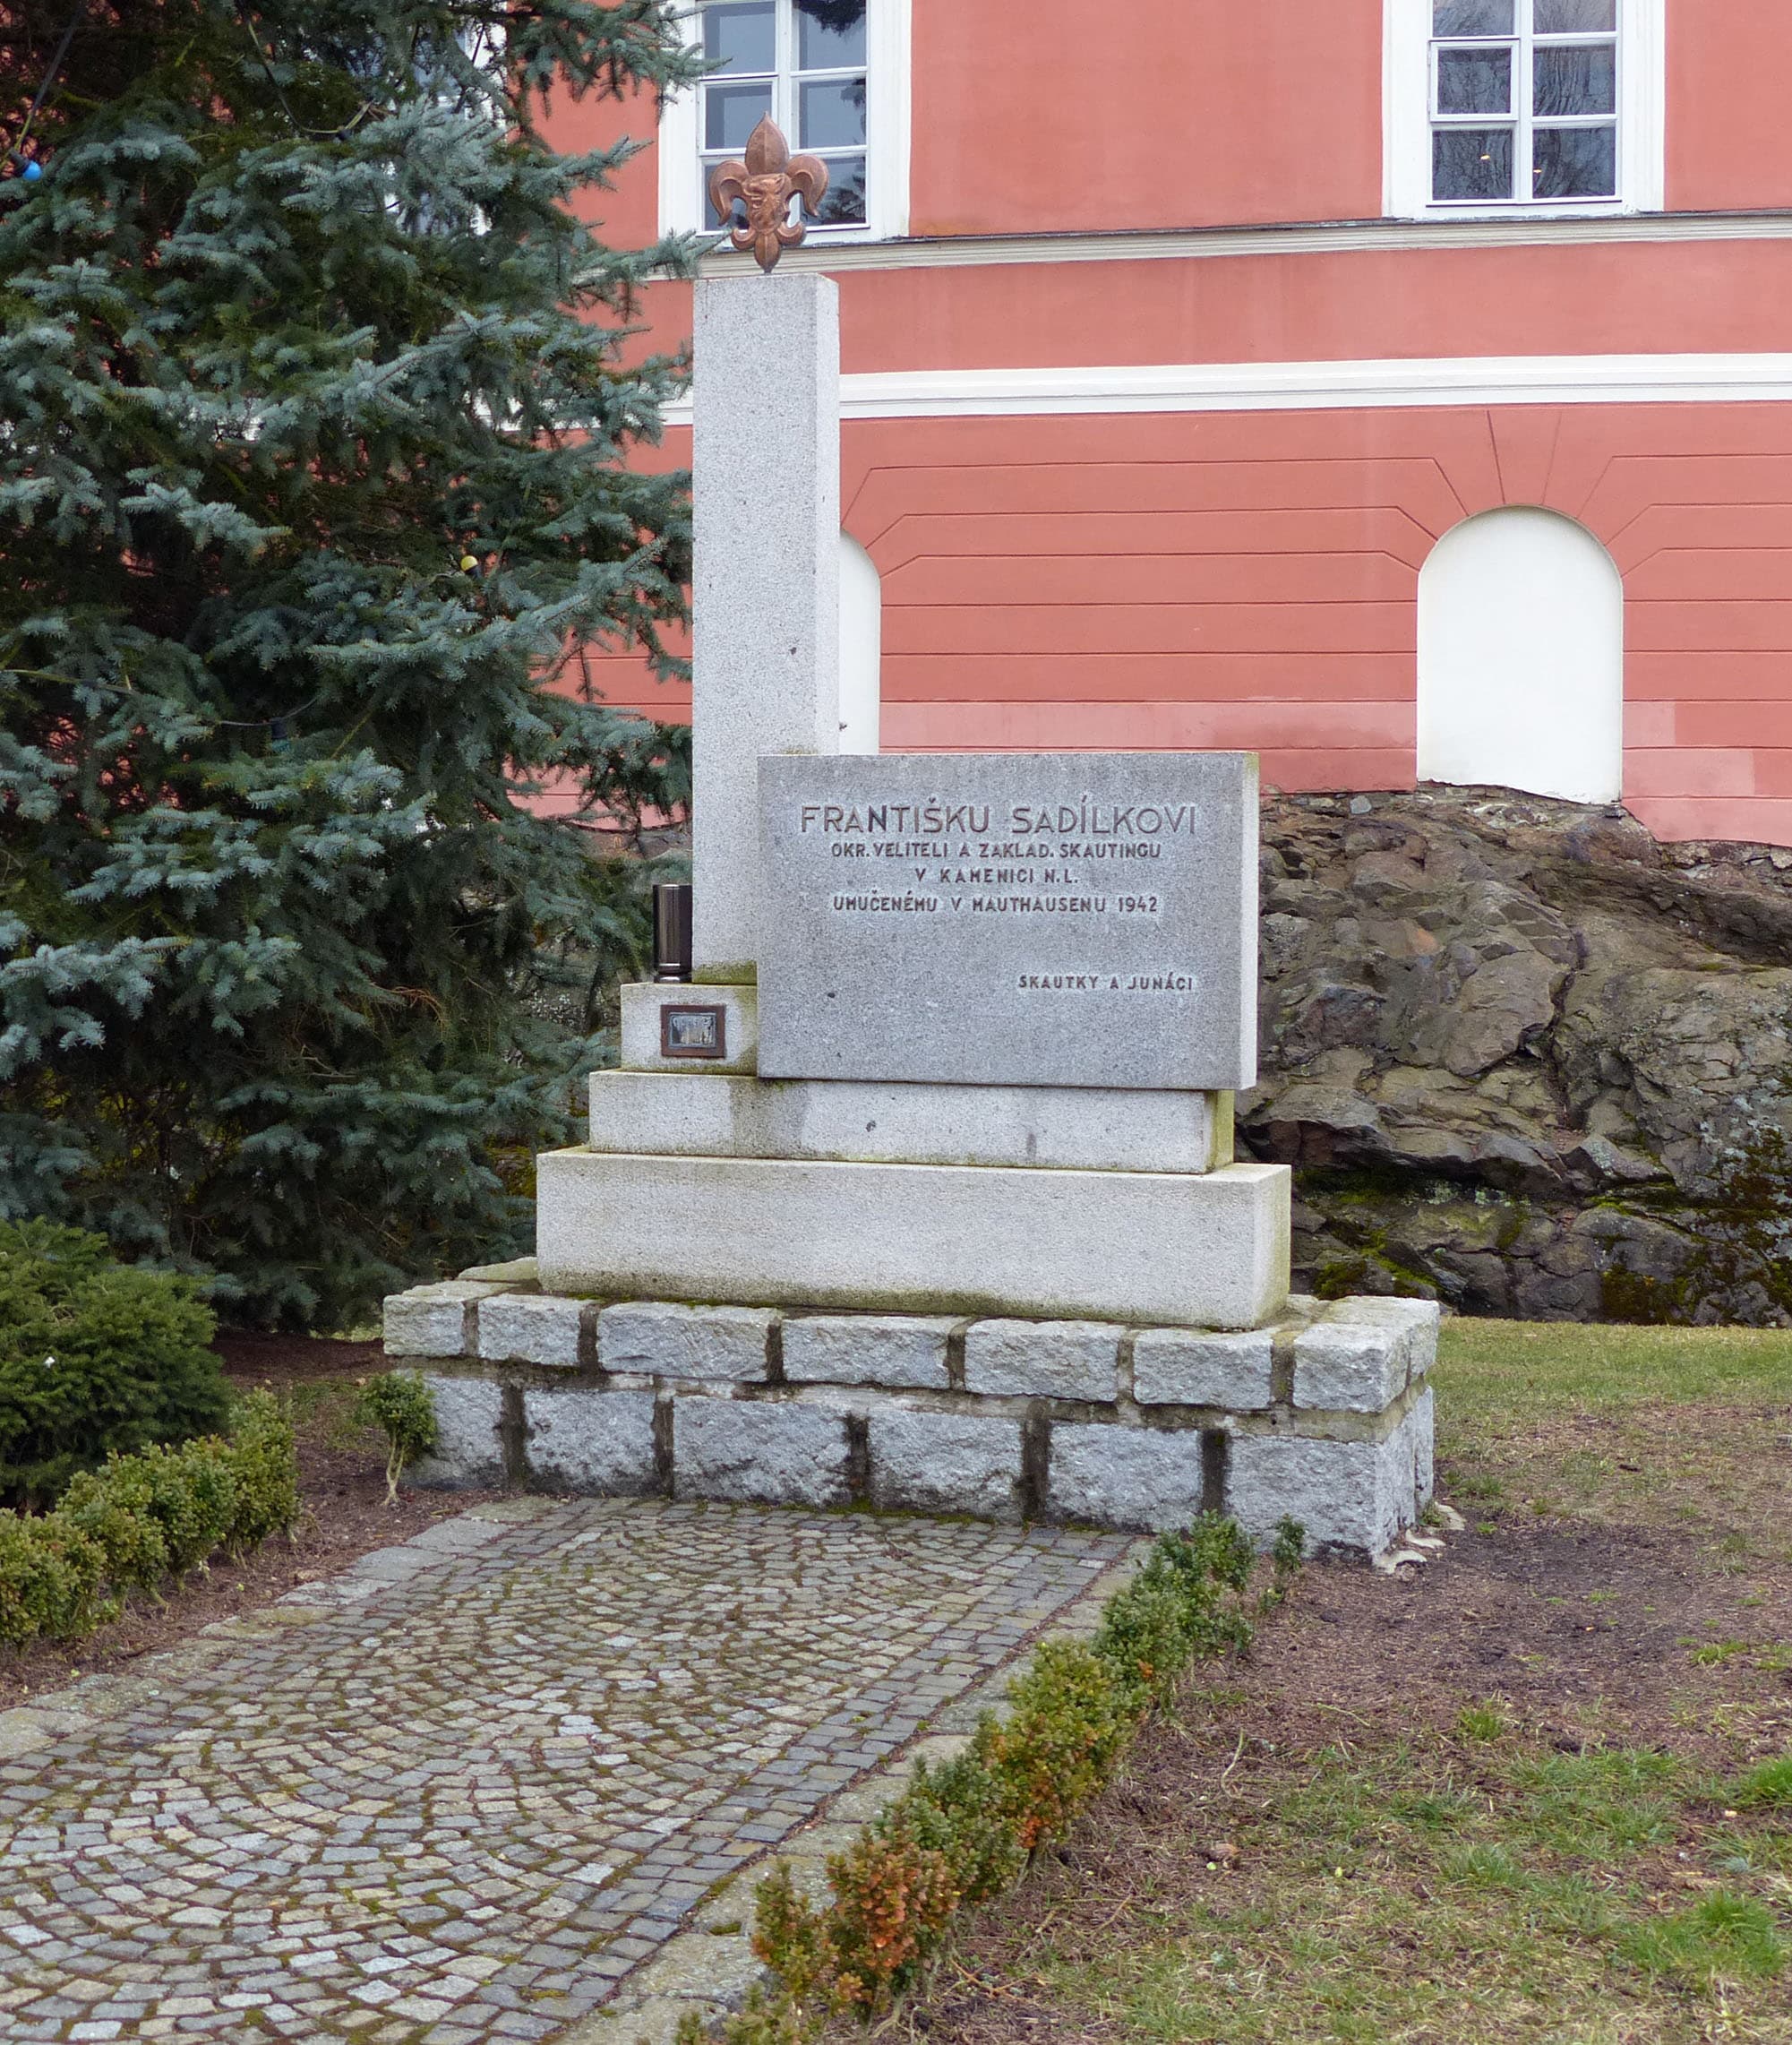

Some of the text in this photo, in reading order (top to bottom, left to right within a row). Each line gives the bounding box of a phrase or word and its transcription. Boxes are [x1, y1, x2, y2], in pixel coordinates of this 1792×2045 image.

[801, 795, 1196, 835] FRANTIŠKU SADÍLKOVI
[958, 843, 971, 858] A
[978, 842, 1055, 859] ZAKLAD.
[1059, 842, 1162, 859] SKAUTINGU
[914, 867, 927, 883] V
[939, 867, 1034, 884] KAMENICI
[833, 889, 1158, 913] UMUČENÉMU V MAUTHAUSENU 1942
[1018, 971, 1193, 991] SKAUTKY A JUNÁCI
